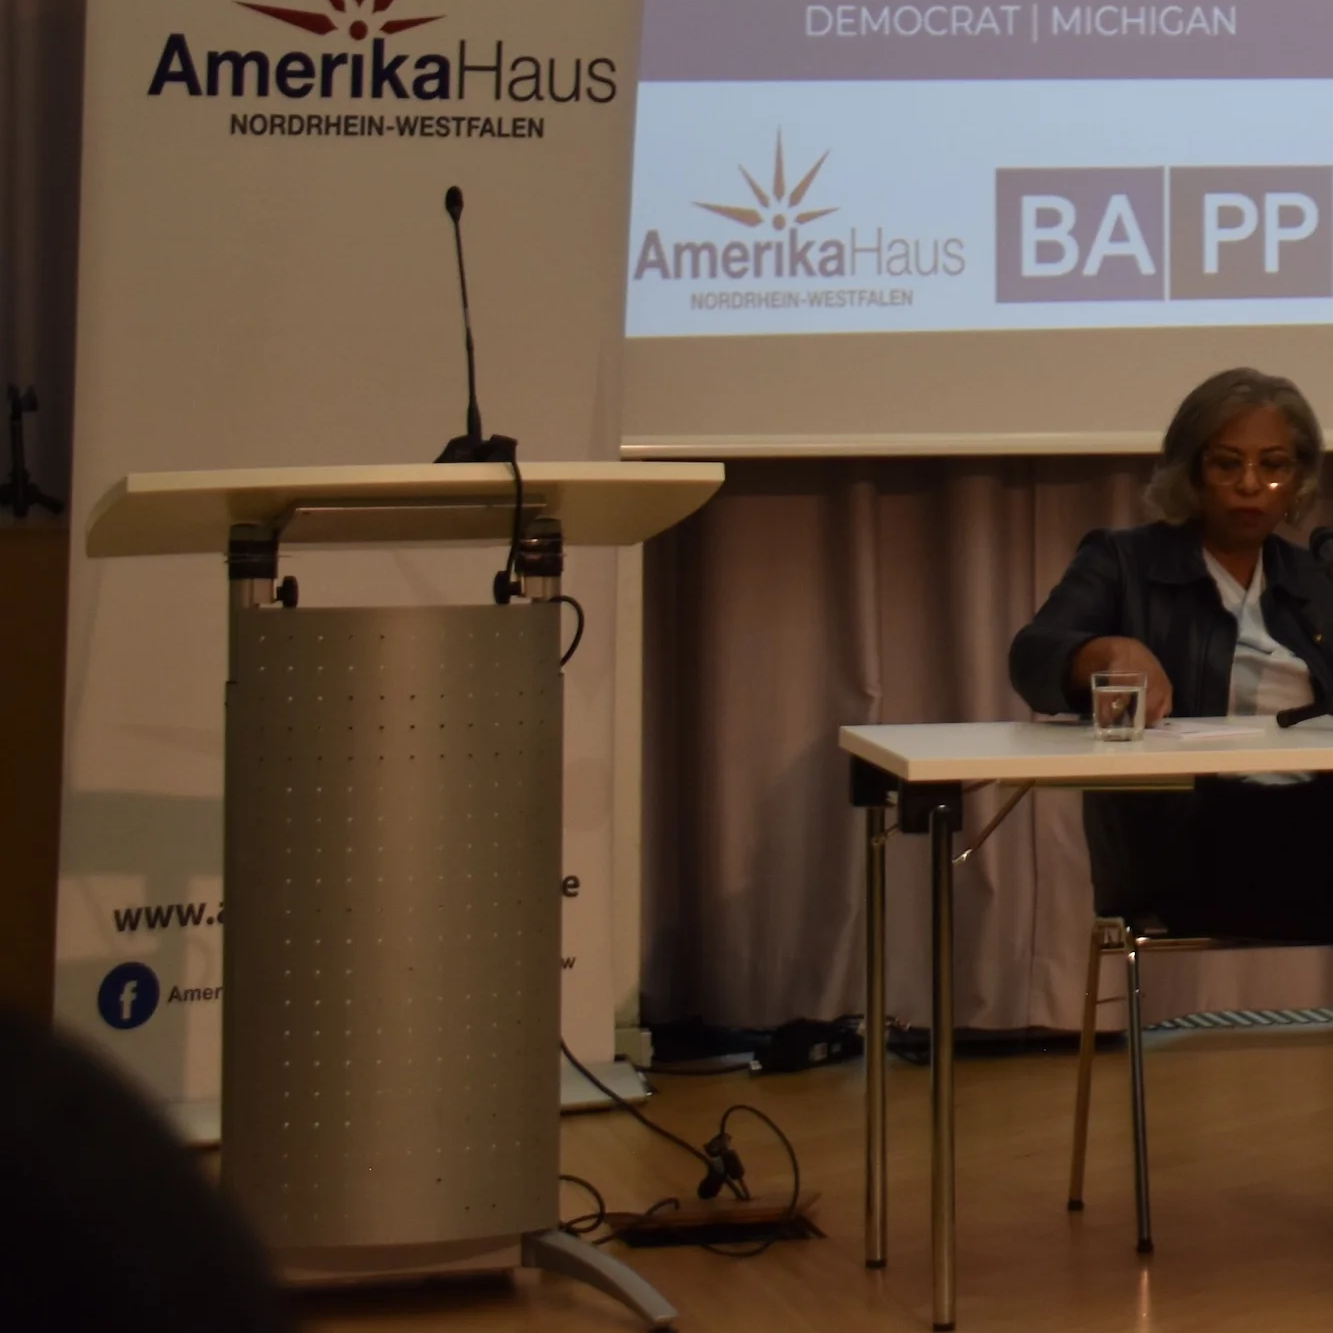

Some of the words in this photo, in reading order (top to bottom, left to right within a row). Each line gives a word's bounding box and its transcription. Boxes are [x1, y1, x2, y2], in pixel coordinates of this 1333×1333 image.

[805, 5, 1020, 36] DEMOCRAT
[1052, 5, 1237, 36] MICHIGAN
[147, 33, 617, 104] AmerikaHaus
[230, 113, 544, 139] NORDRHEIN-WESTFALEN
[690, 289, 914, 310] NORDRHEIN-WESTFALEN
